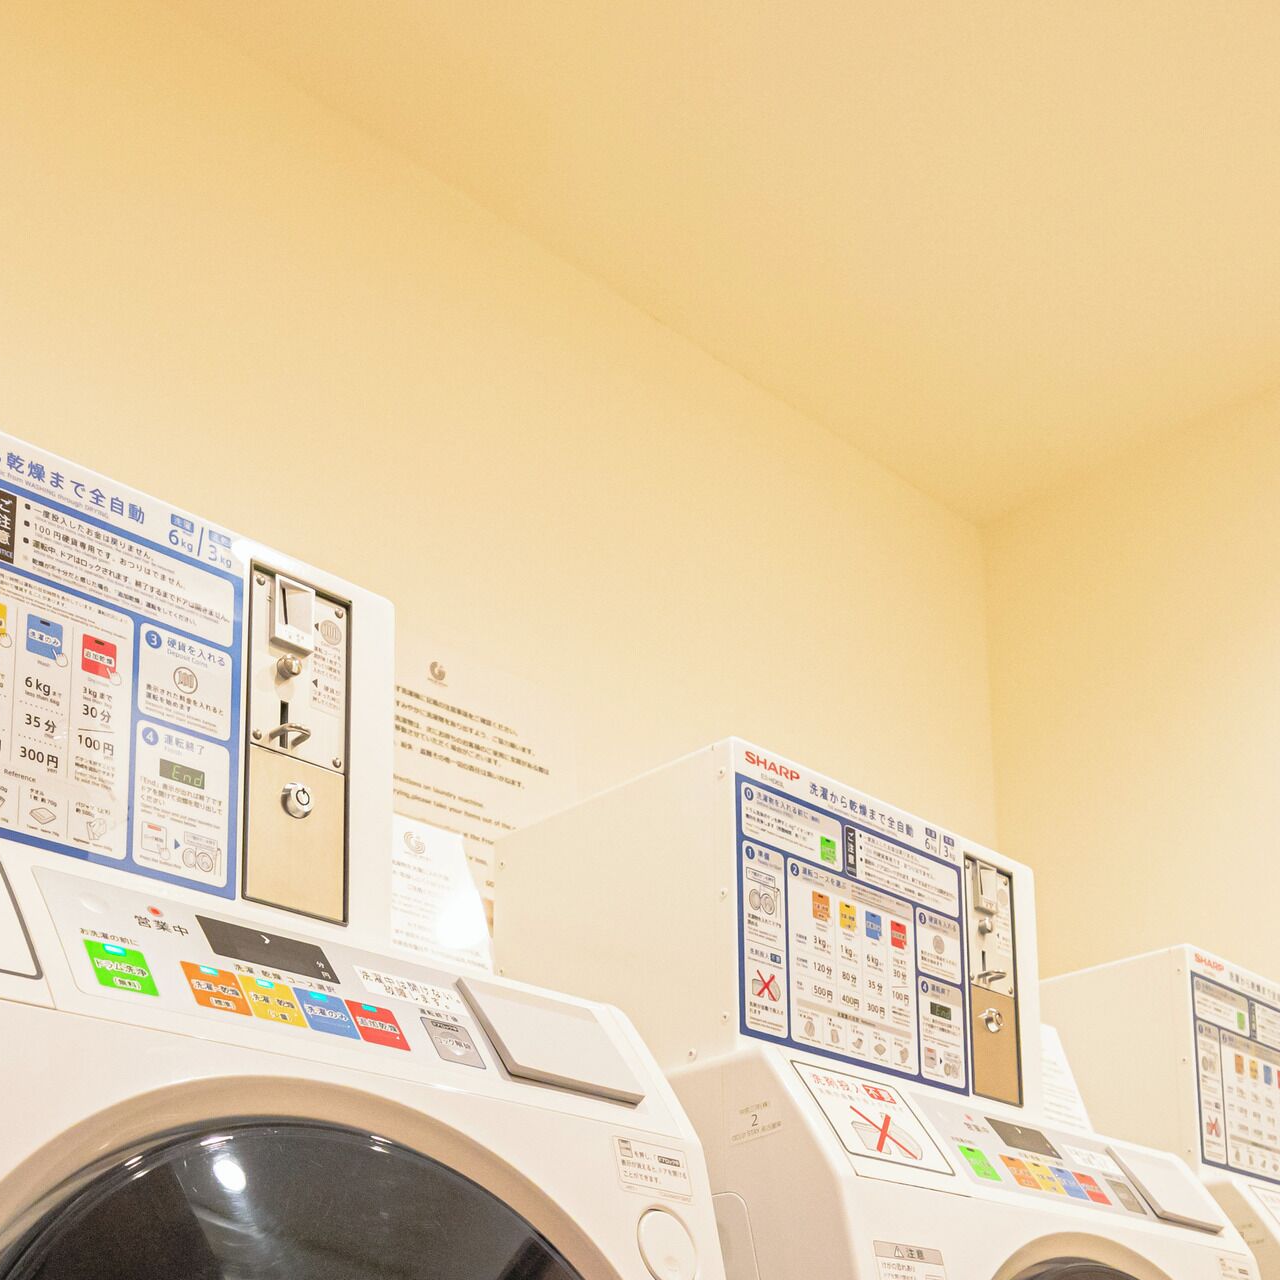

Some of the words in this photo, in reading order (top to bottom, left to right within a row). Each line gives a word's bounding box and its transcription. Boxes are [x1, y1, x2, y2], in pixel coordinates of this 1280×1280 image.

[25, 479, 55, 498] WASHING
[168, 527, 179, 546] 6
[180, 535, 193, 553] kg
[208, 544, 217, 562] 3
[220, 552, 231, 569] kg
[167, 636, 225, 668] 硬貨を入れる
[35, 678, 50, 696] kg
[25, 712, 56, 734] 35分
[82, 703, 111, 724] 30分
[77, 733, 113, 756] 100円
[164, 733, 204, 756] 運転終了
[19, 745, 58, 769] 300円
[744, 749, 800, 782] SHARP
[3, 768, 36, 783] Reference
[172, 763, 203, 788] End
[809, 781, 913, 837] 洗濯から乾燥まで全自動
[134, 915, 189, 937] 営業中
[95, 958, 149, 977] ドラム洗浄
[813, 961, 832, 976] 120分
[1194, 951, 1224, 975] SHARP
[842, 970, 856, 984] 80分
[893, 968, 906, 981] 30分
[813, 984, 833, 1000] 500円
[867, 979, 882, 992] 35分
[841, 993, 859, 1008] 400円
[892, 990, 909, 1005] 100円
[866, 1001, 885, 1016] 300円
[751, 1113, 759, 1127] 2
